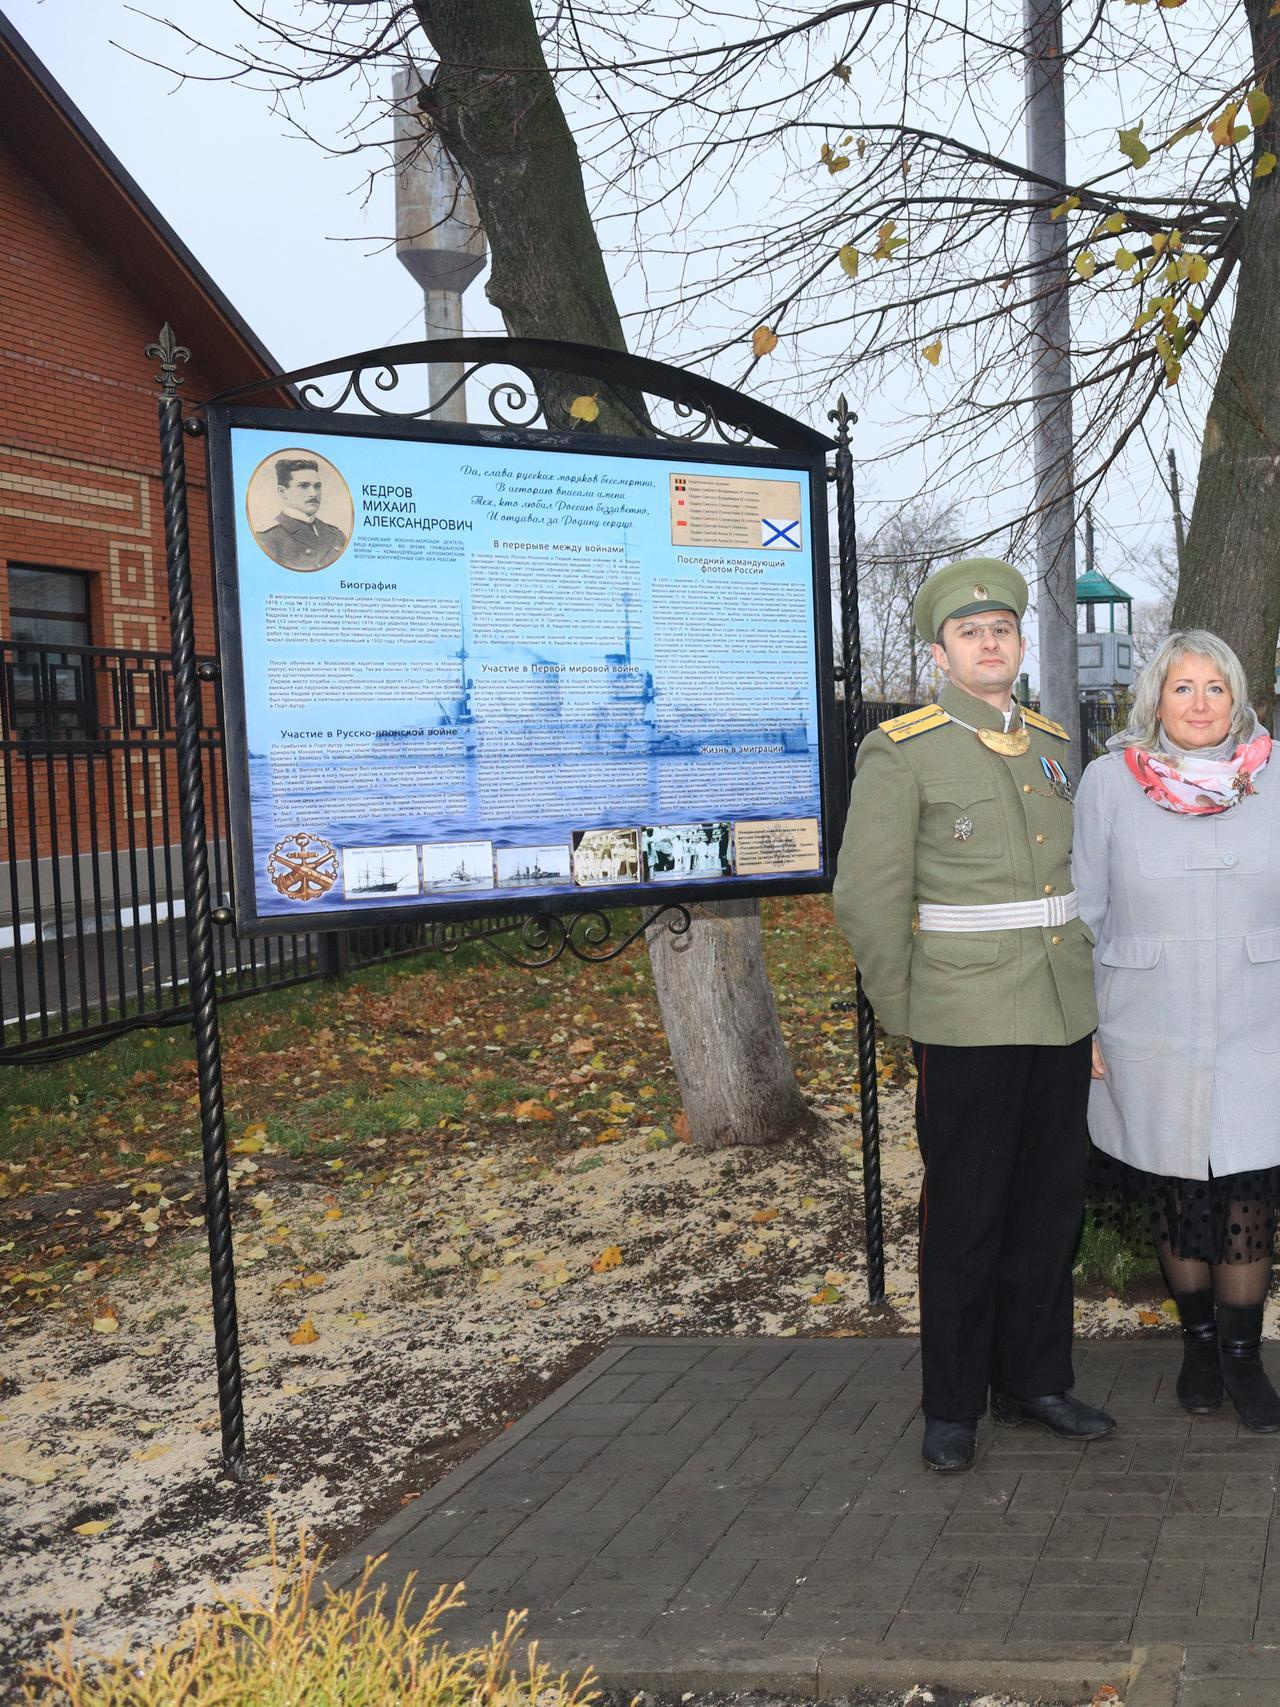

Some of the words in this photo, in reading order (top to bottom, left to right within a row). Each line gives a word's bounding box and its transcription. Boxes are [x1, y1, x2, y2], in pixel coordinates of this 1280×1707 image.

[362, 484, 412, 498] КЕДРОВ
[496, 482, 506, 492] В
[509, 486, 552, 495] историю
[556, 486, 594, 497] вписали
[598, 491, 625, 499] имена
[363, 500, 416, 513] МИХАИЛ
[471, 496, 496, 507] Тех,
[500, 497, 518, 506] кто
[522, 500, 552, 510] любил
[555, 501, 593, 512] Россию
[596, 502, 650, 516] беззаветно,
[364, 516, 472, 530] АЛЕКСАНДРОВИЧ
[494, 540, 499, 548] В
[502, 541, 550, 551] перерыве
[552, 544, 582, 554] между
[586, 543, 624, 554] войнами
[677, 556, 724, 566] Последний
[726, 559, 785, 568] командующий
[701, 565, 732, 574] флотом
[734, 566, 764, 574] России
[340, 580, 397, 592] Биография
[482, 664, 520, 673] Участие
[531, 664, 566, 674] Первой
[569, 664, 610, 674] мировой
[612, 664, 639, 672] войне
[280, 729, 323, 740] Участие
[336, 728, 424, 740] Русско-японской
[428, 728, 458, 737] войне
[701, 746, 728, 754] Жизнь
[738, 744, 784, 754] эмиграции
